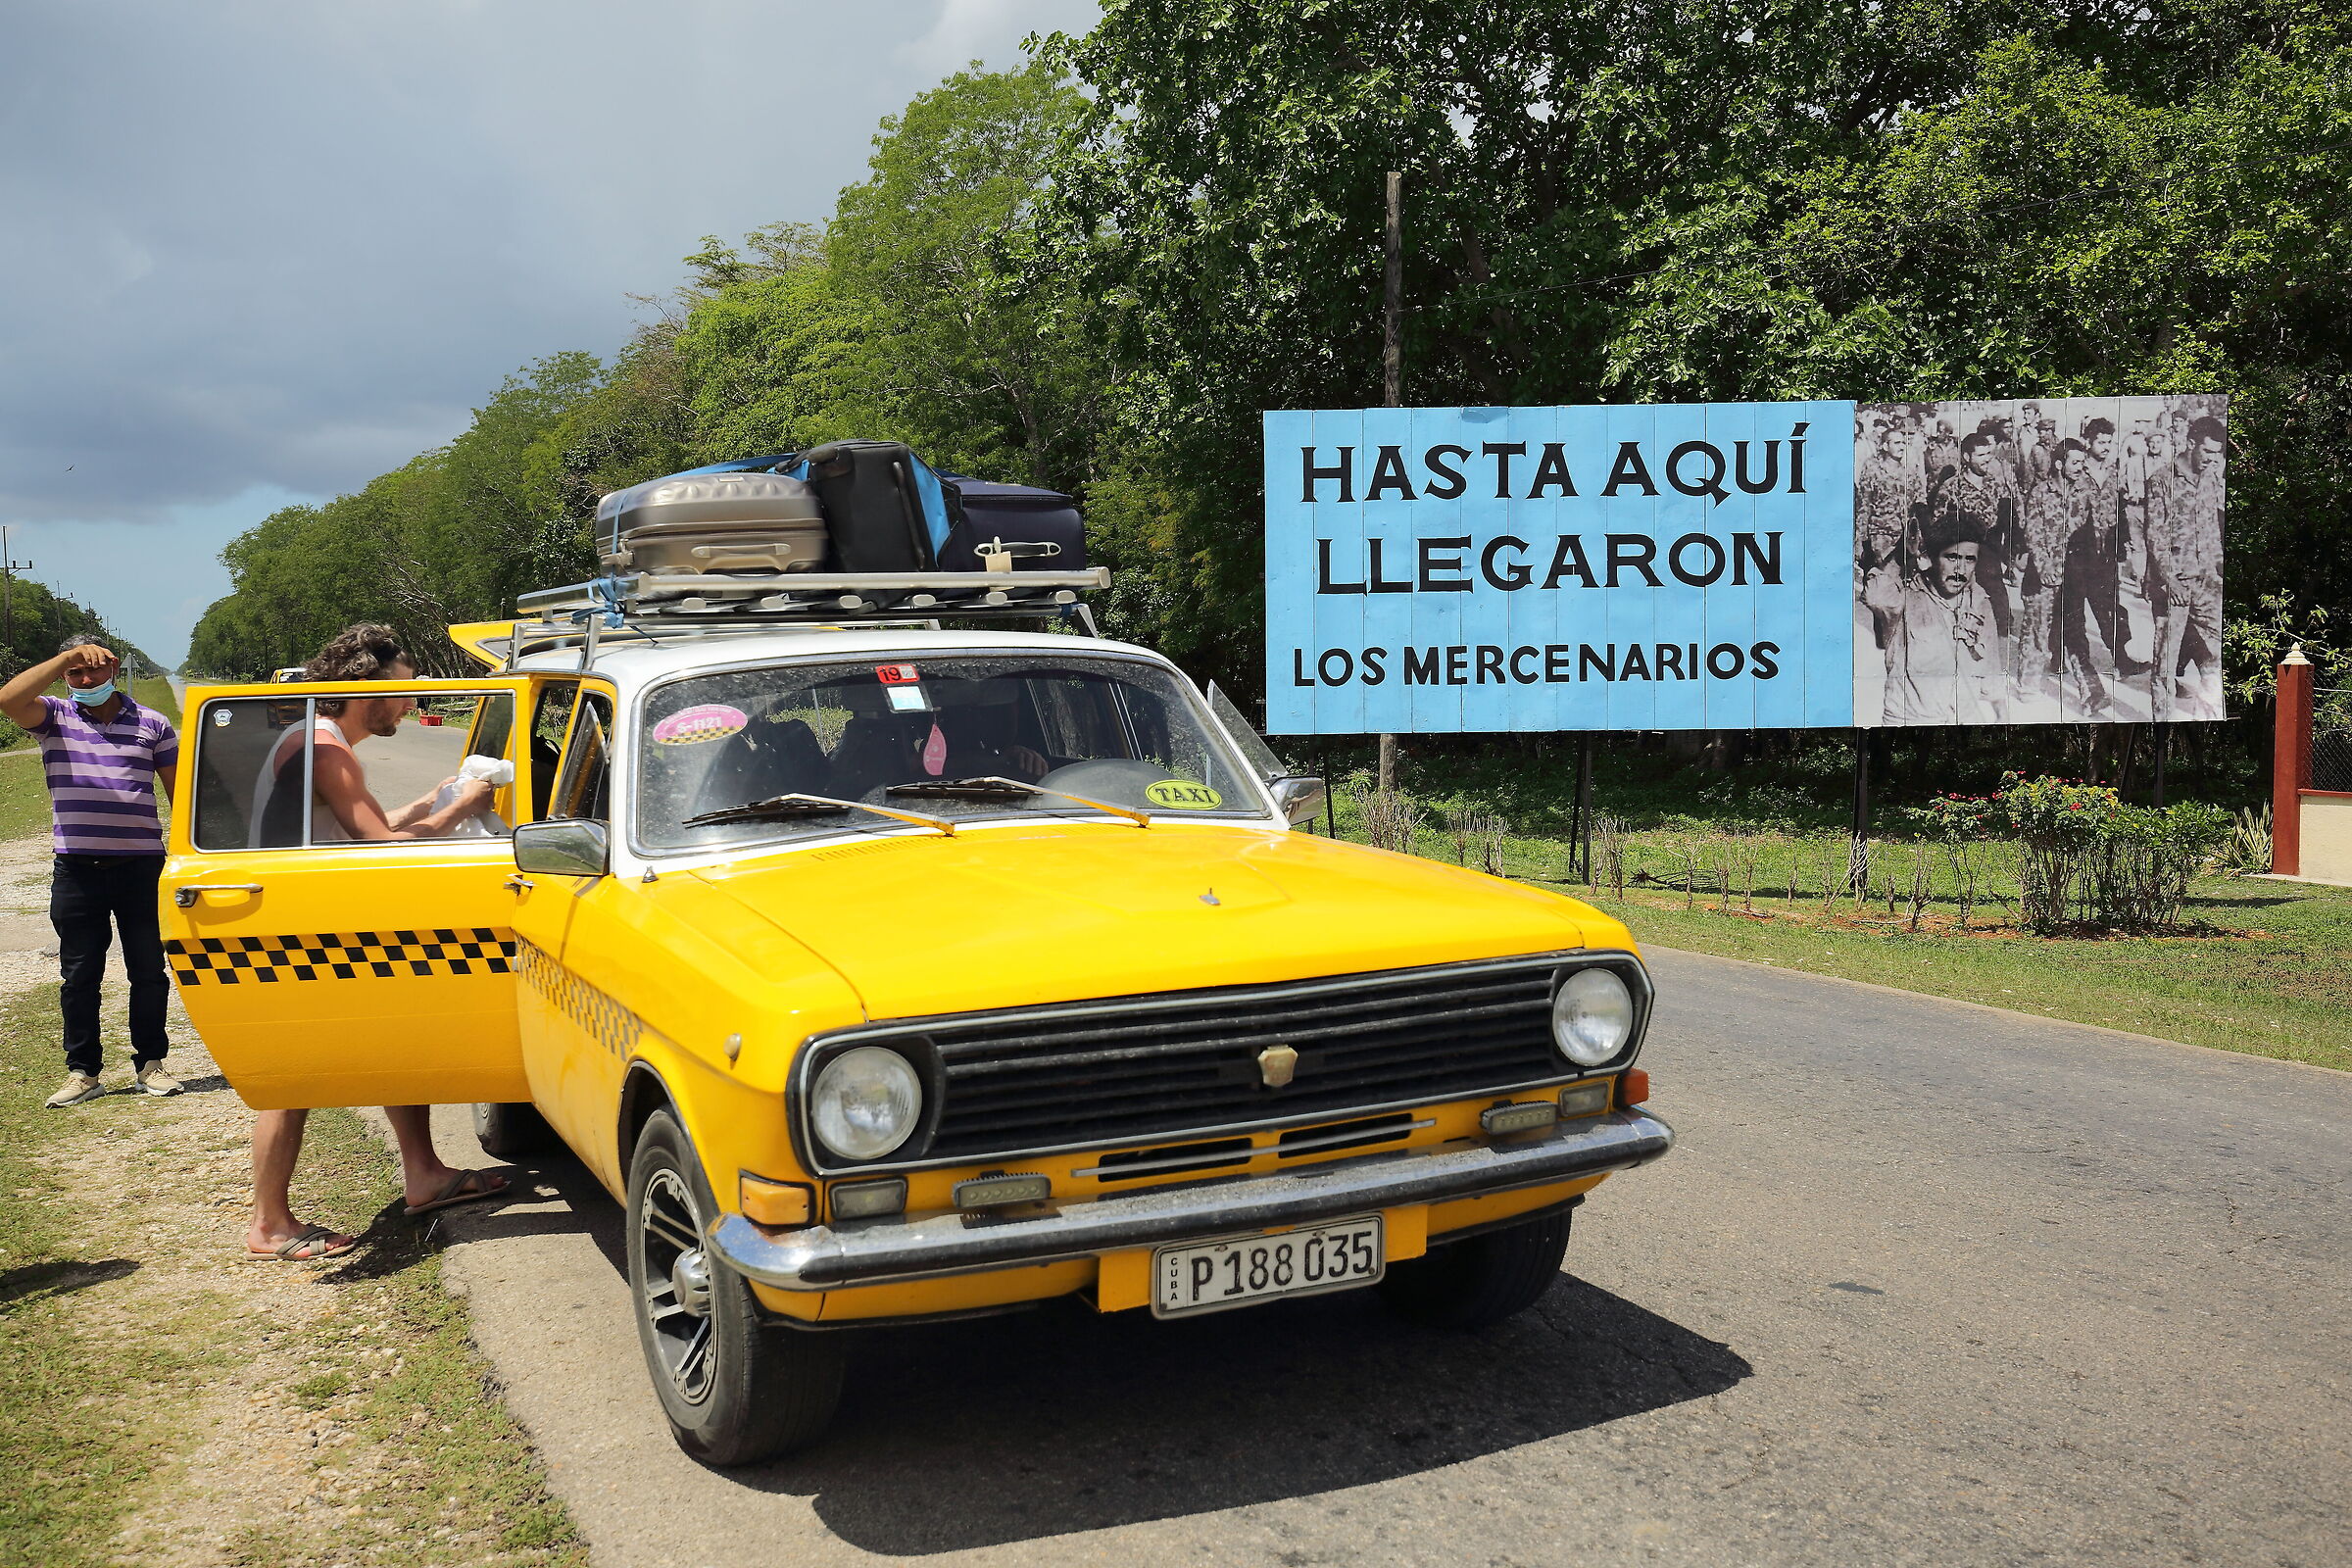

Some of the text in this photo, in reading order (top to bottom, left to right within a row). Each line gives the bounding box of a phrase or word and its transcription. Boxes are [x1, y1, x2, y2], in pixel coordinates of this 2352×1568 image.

[1300, 421, 1811, 509] HASTA AQUÍ
[1316, 531, 1785, 596] LLEGARON
[878, 666, 902, 682] 19
[1294, 641, 1781, 687] LOS MERCENARIOS
[1154, 787, 1214, 803] TAXI
[1169, 1256, 1179, 1301] CUBA
